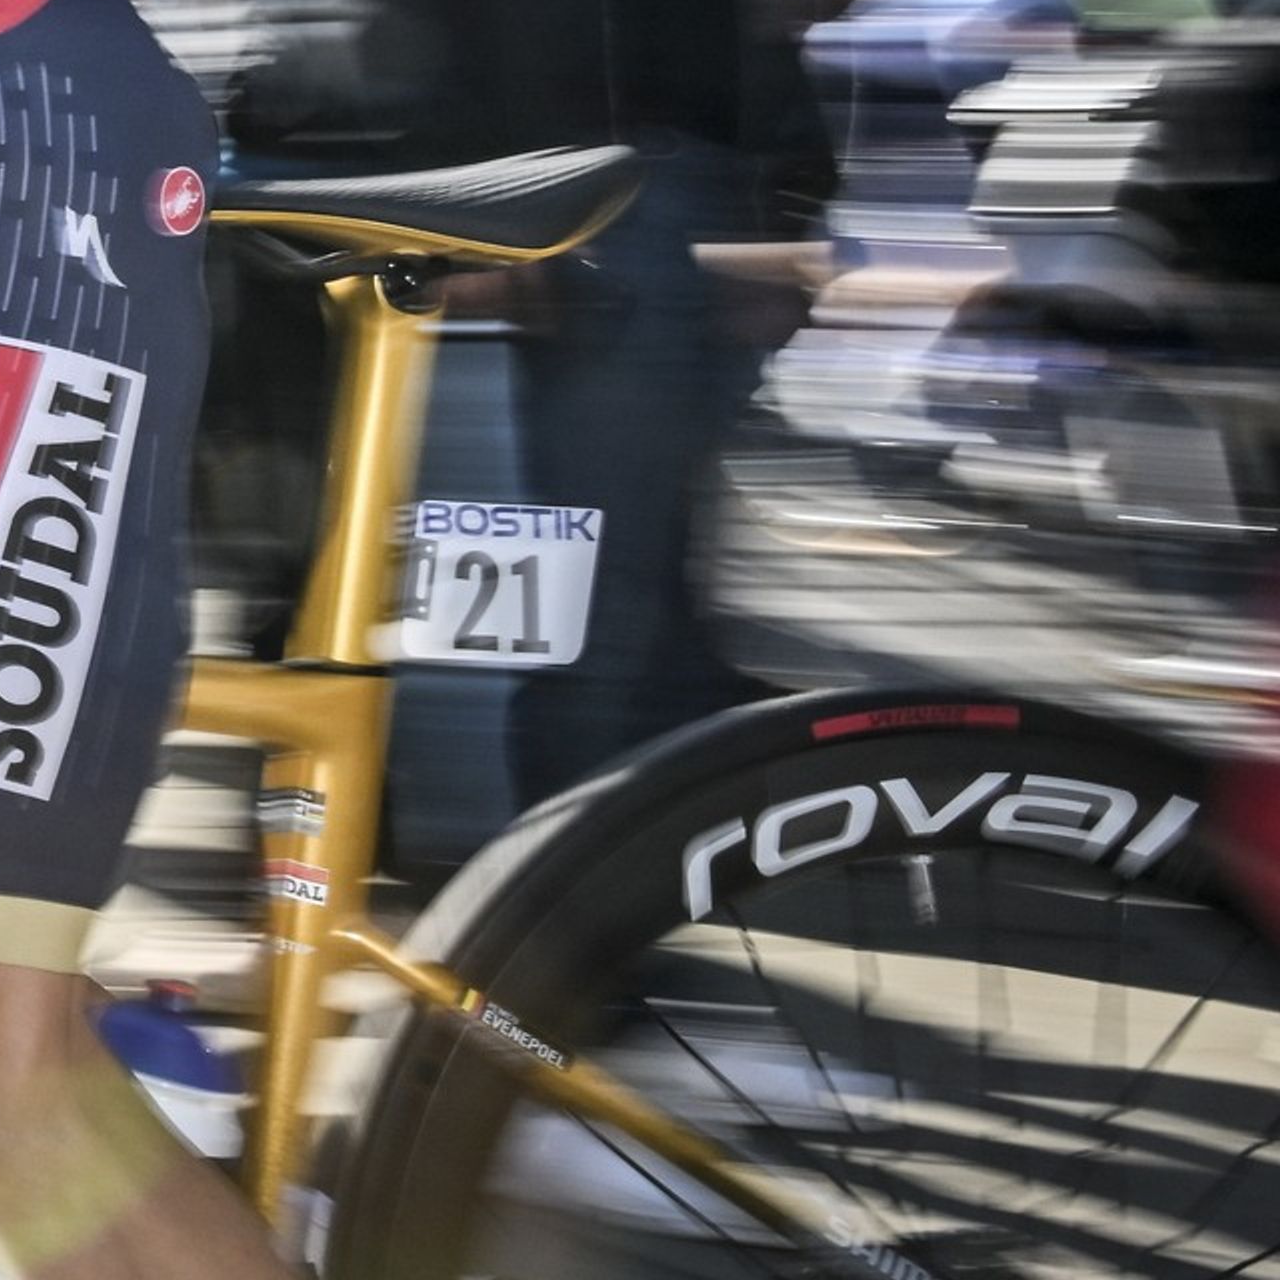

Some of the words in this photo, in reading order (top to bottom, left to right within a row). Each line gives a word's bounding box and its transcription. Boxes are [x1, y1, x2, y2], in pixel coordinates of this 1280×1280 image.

[421, 503, 596, 542] BOSTIK
[452, 550, 551, 654] 21
[481, 1008, 565, 1071] EVENEPOEL
